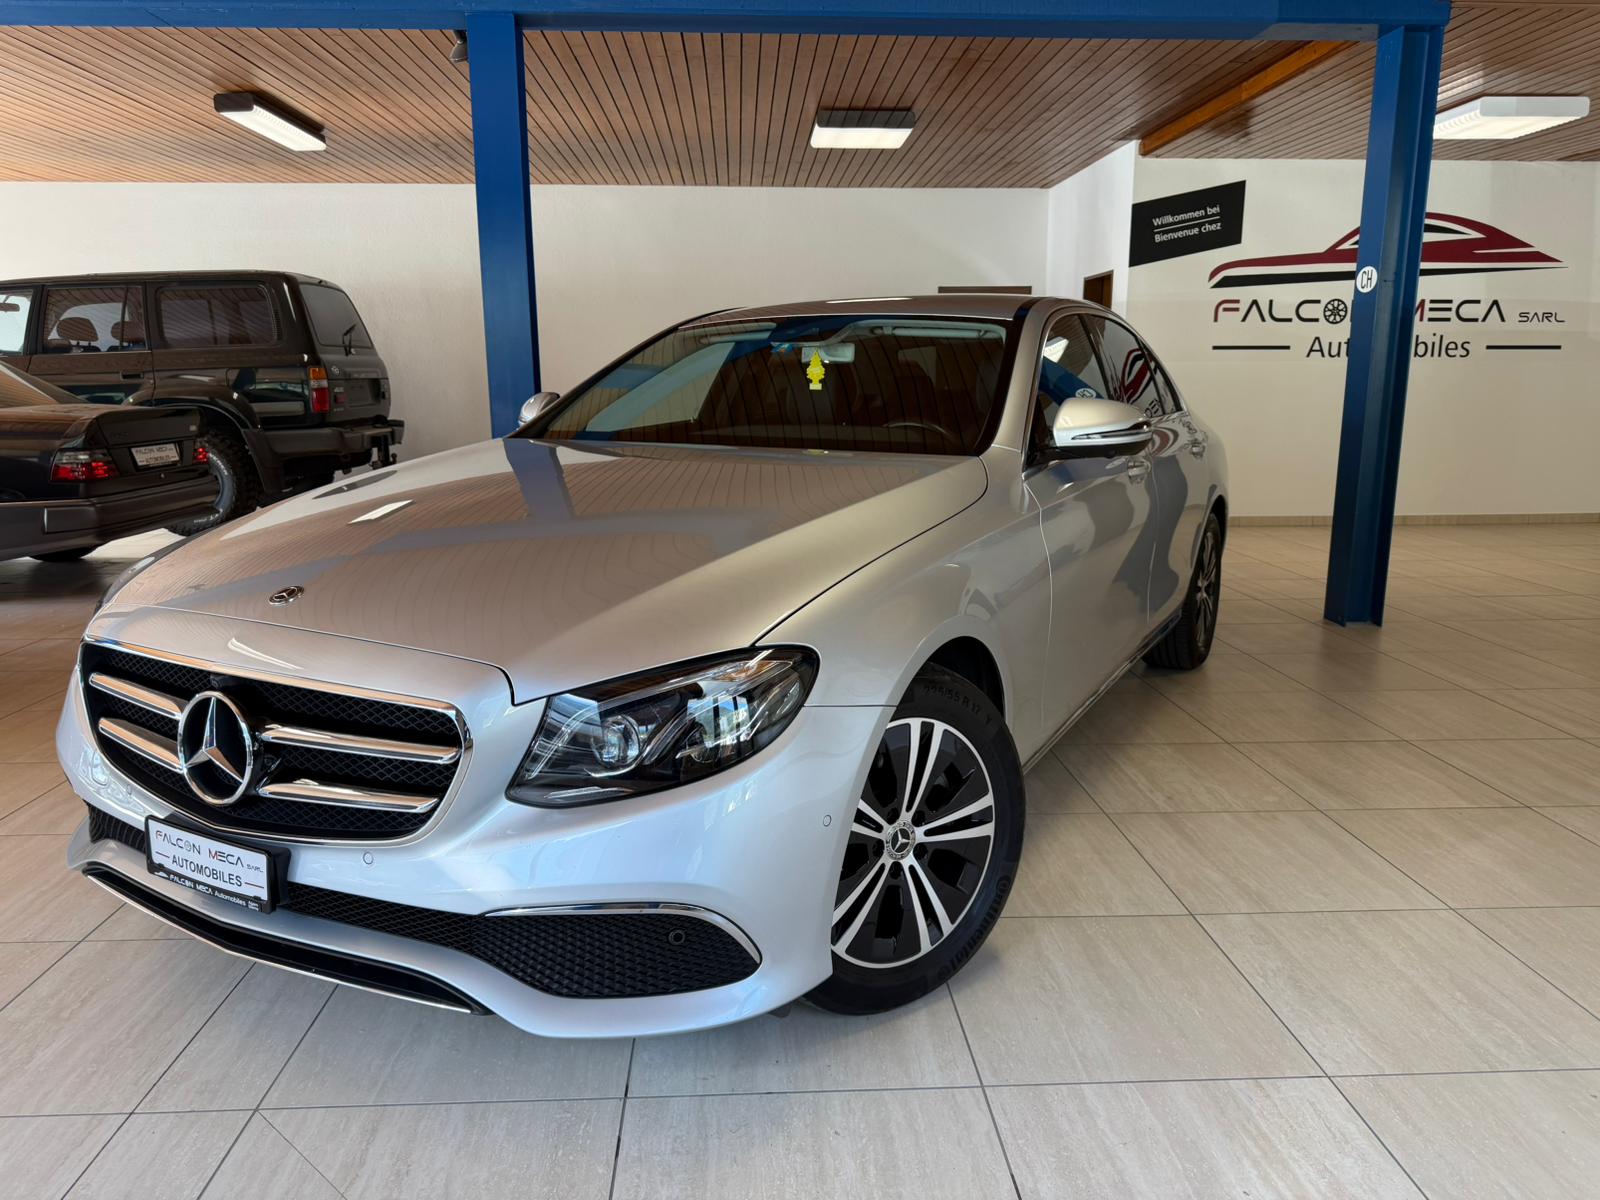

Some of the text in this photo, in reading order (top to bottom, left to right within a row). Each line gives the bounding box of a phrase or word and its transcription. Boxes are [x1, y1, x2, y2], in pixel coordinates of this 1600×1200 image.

[1152, 204, 1220, 226] Willkommen bei
[1154, 222, 1222, 243] Bienvenue chez
[1360, 269, 1373, 289] CH
[1213, 298, 1354, 324] FALCO
[1518, 311, 1566, 323] SARL
[155, 830, 201, 855] FALCON
[208, 848, 244, 868] MECA
[172, 854, 242, 887] AUTOMOBILES
[214, 890, 246, 907] Automobiles
